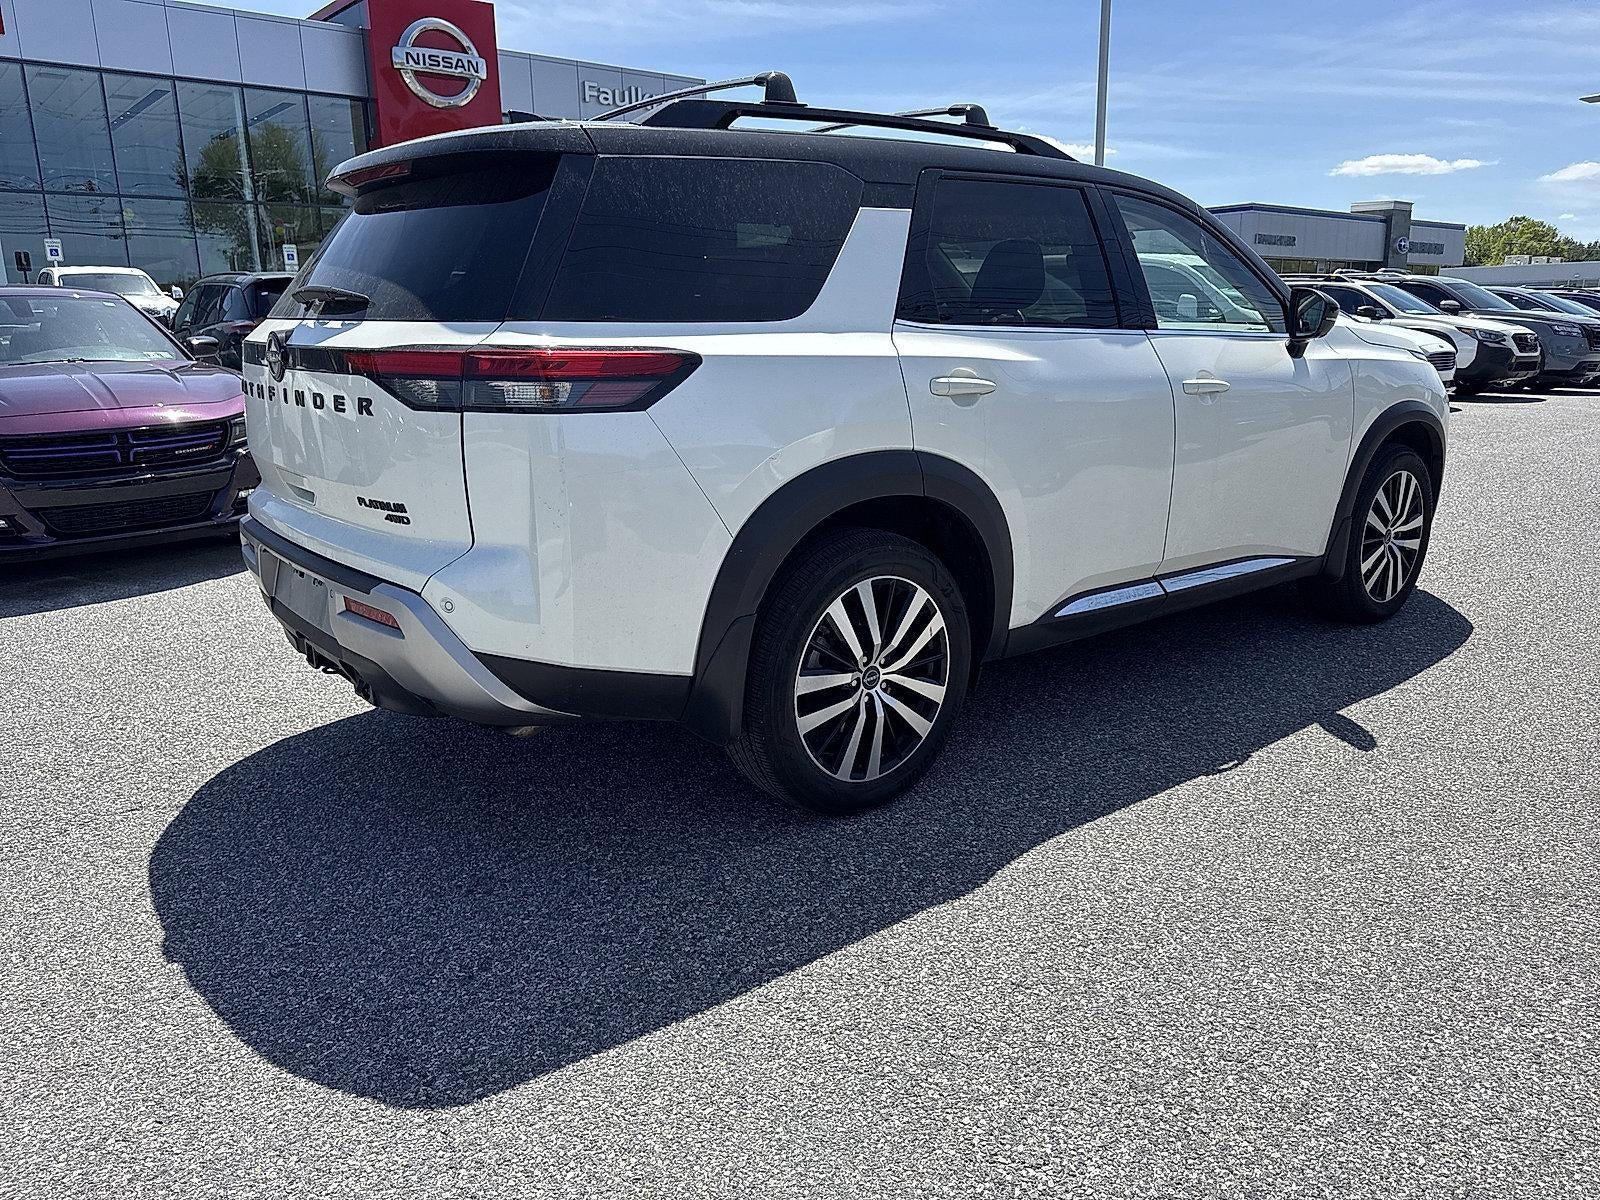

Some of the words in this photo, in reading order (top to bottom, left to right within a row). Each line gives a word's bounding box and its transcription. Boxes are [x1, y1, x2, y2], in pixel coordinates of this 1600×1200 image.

[404, 51, 480, 74] NISSAN
[241, 378, 375, 417] ATHFINDER
[356, 496, 408, 513] PLATINUM
[384, 513, 411, 525] 4WD
